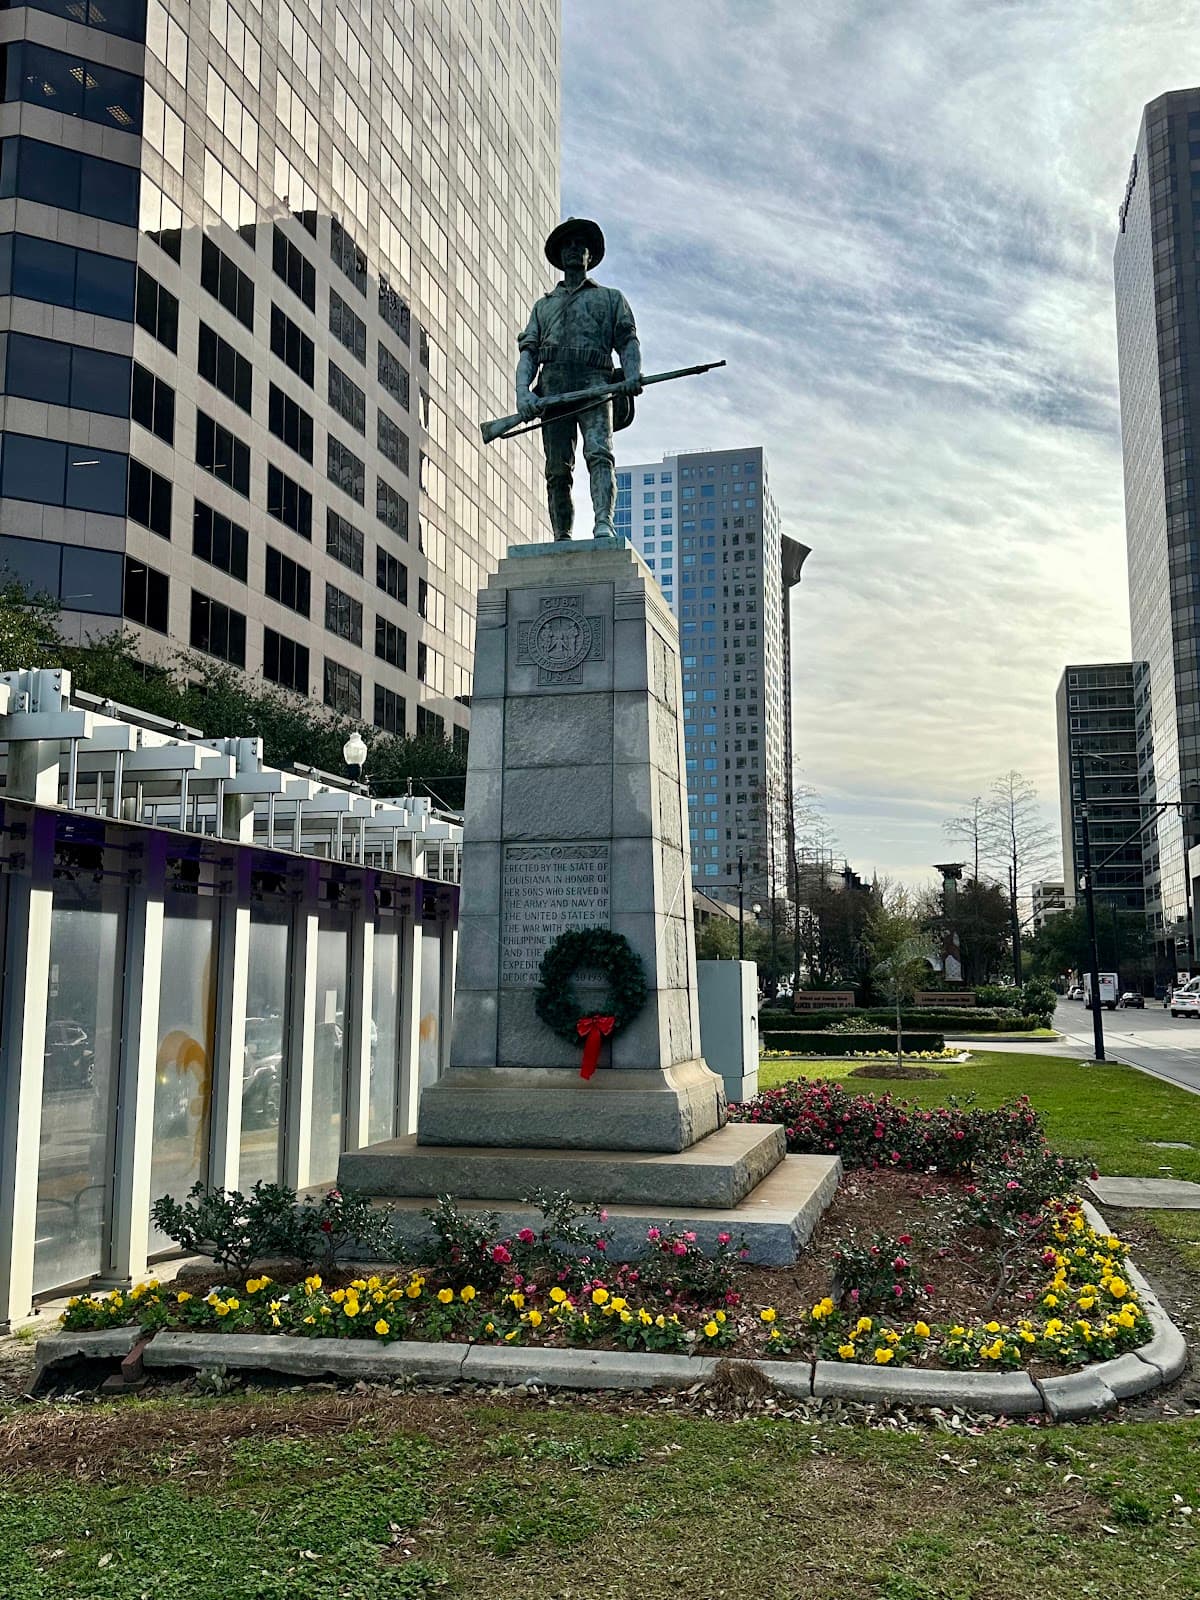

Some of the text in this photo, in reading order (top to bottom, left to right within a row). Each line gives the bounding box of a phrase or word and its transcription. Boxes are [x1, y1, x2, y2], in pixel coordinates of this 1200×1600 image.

[543, 598, 578, 608] CUBA
[504, 862, 609, 873] ERECTED BY THE STATE OF
[504, 874, 609, 885] LOUISIANA IN HONOR OF
[504, 886, 609, 897] HER SONS WHO SERVED IN
[504, 898, 609, 909] THE ARMY AND NAVY OF
[504, 910, 609, 921] THE UNITED STATES IN
[503, 924, 520, 933] THE
[522, 924, 540, 933] WAR
[542, 923, 562, 933] WITH
[503, 936, 547, 945] PHILIPPINE
[503, 948, 543, 958] AND THE
[503, 960, 539, 970] EXPEDIT
[503, 972, 543, 982] DEDICATE
